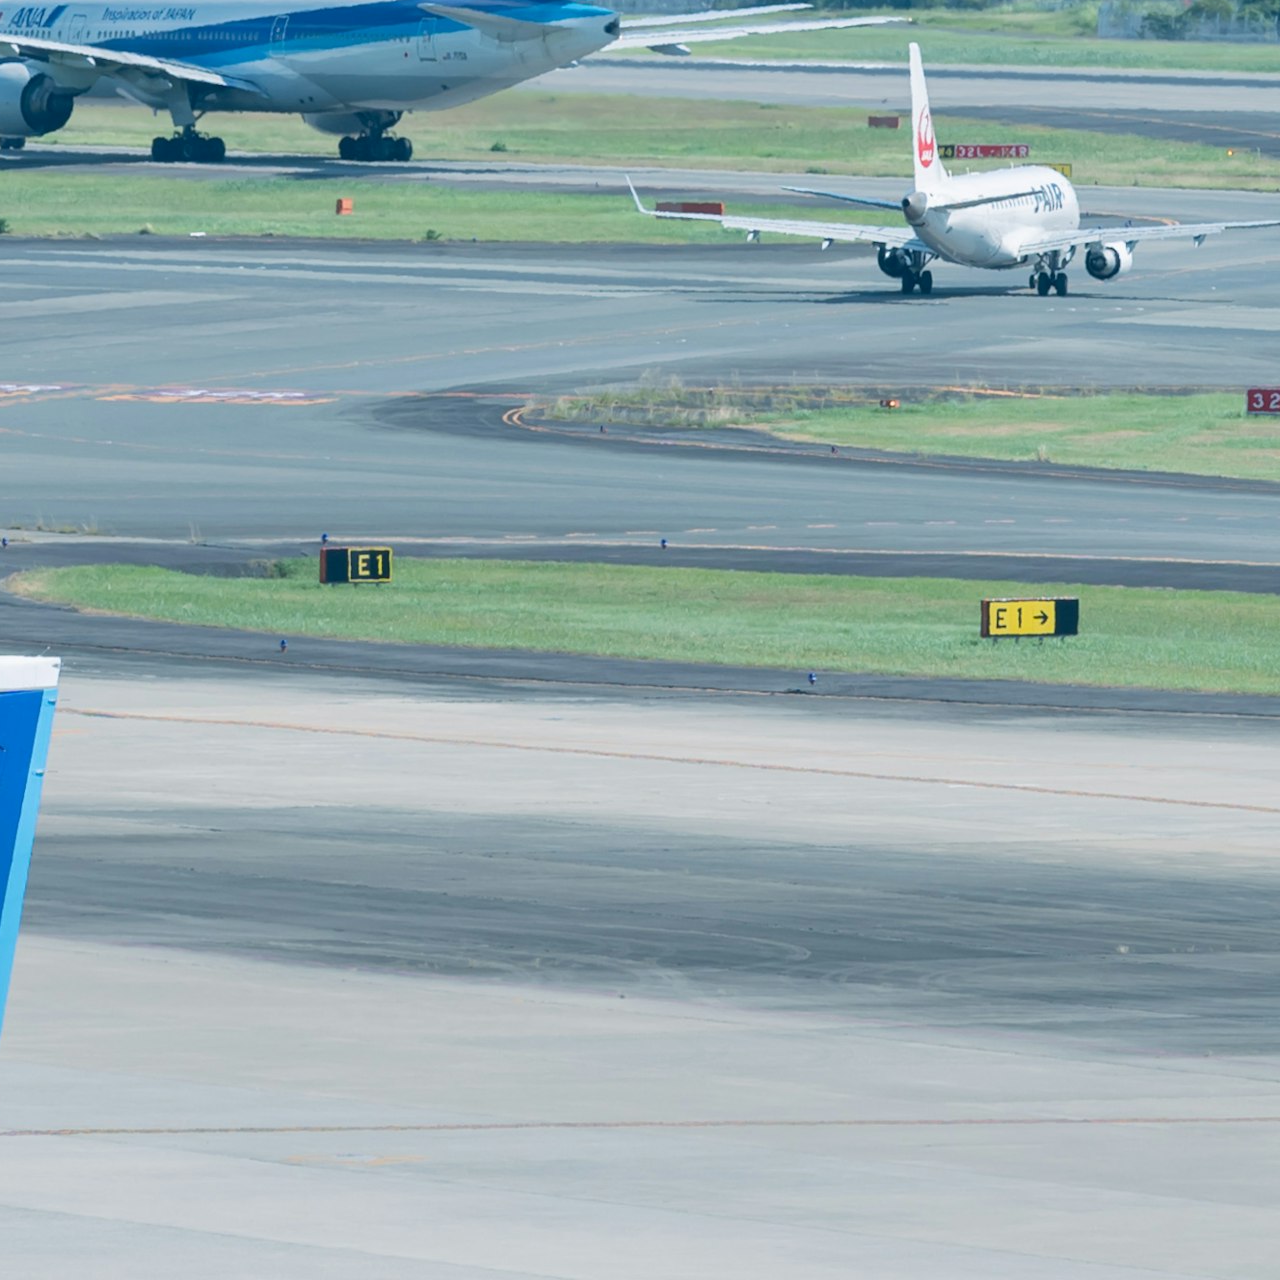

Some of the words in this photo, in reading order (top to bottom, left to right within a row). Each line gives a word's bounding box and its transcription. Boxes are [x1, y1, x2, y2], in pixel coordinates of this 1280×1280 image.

[8, 7, 47, 28] ANA
[358, 553, 384, 577] E1
[995, 607, 1023, 629] E1
